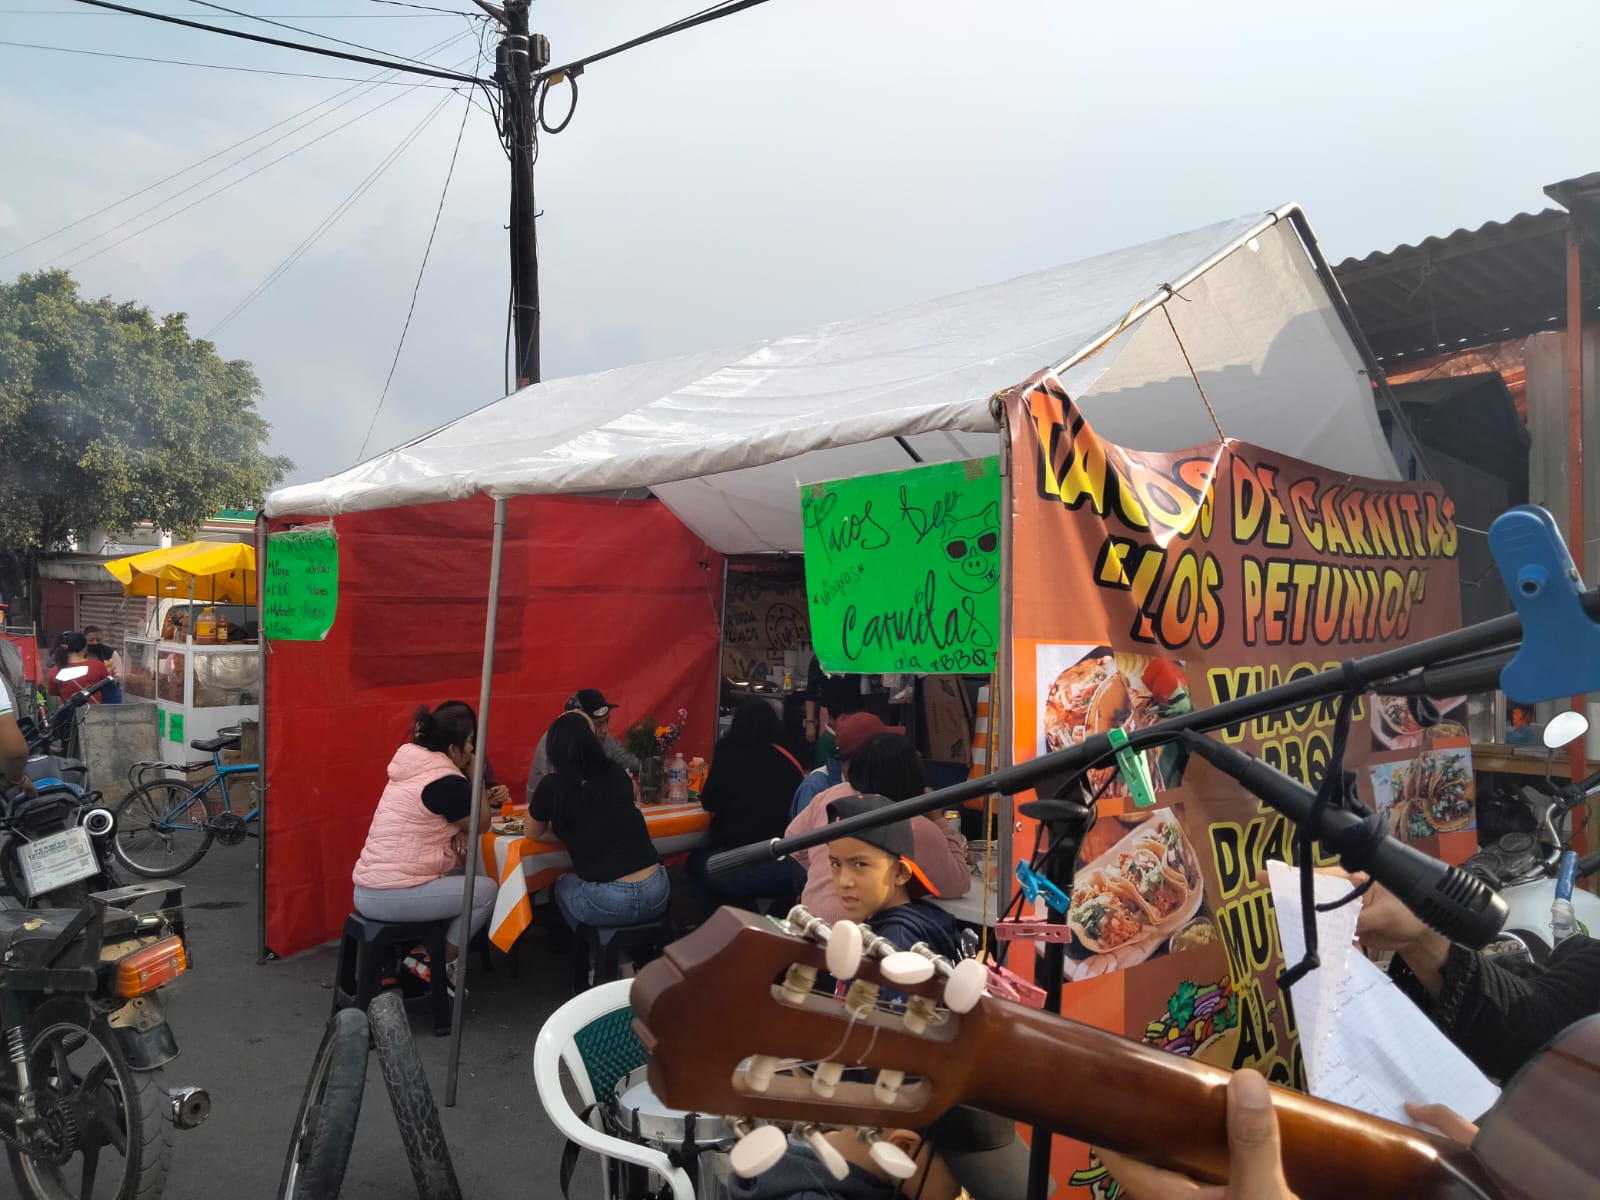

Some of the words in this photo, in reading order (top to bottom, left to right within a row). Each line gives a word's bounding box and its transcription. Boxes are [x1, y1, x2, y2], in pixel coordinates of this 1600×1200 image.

[1231, 450, 1293, 548] DE
[1288, 476, 1459, 559] CARNITAS
[1207, 661, 1364, 745] VIAGR
